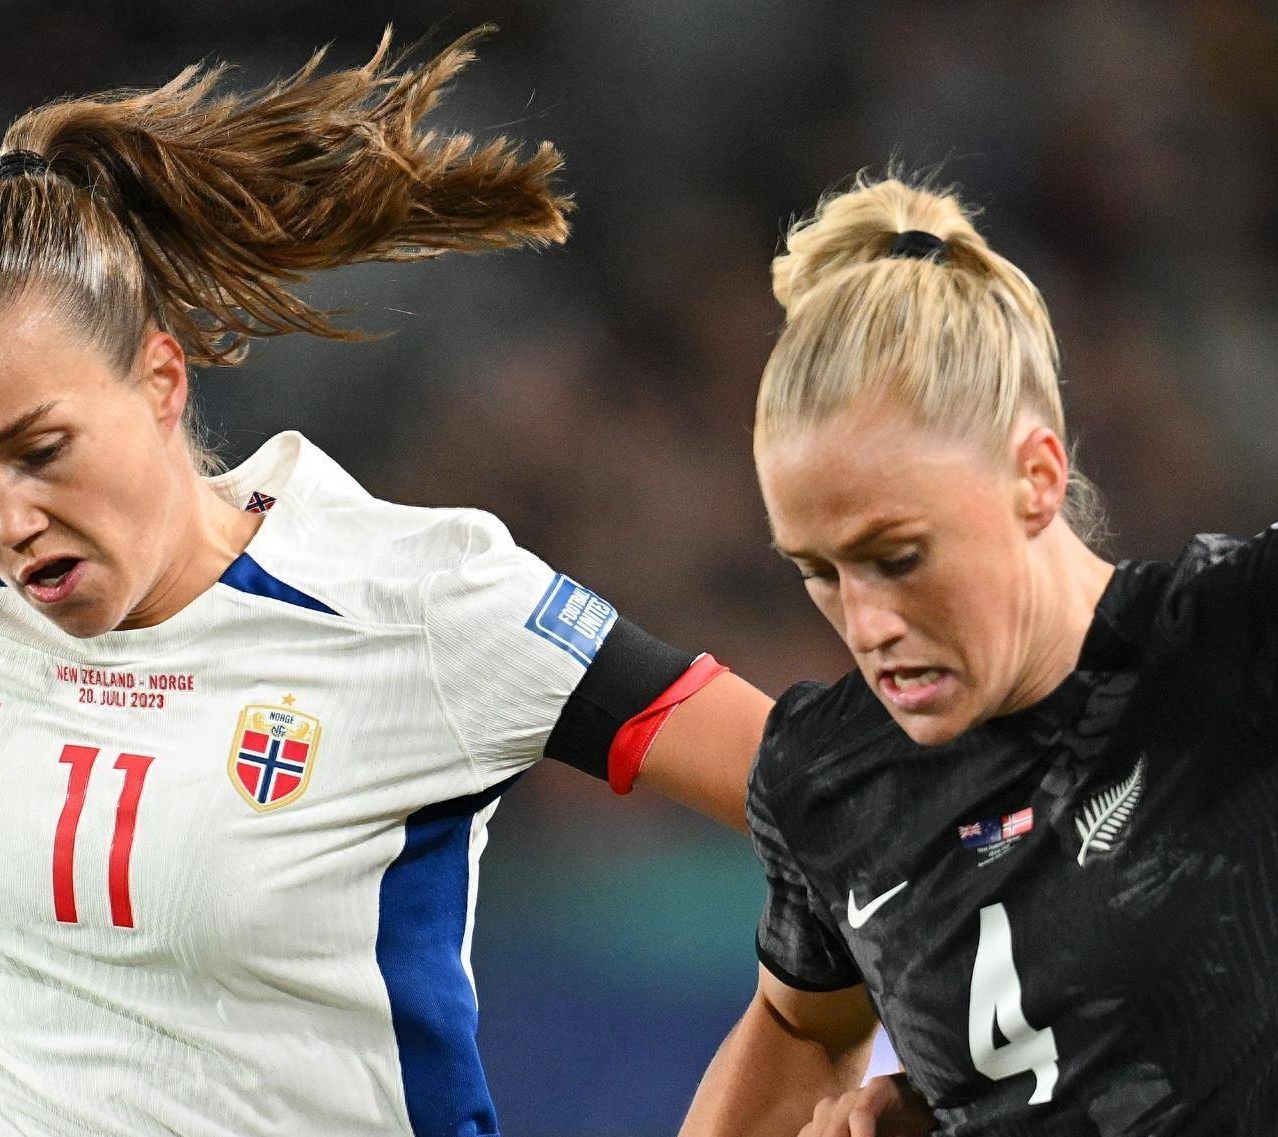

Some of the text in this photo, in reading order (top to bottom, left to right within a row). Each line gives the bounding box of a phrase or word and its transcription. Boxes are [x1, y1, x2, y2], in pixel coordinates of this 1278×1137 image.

[57, 665, 78, 684] NEW
[82, 669, 135, 689] ZEALAND
[149, 674, 195, 691] NORGE
[79, 688, 164, 709] 20. JULI 2023
[269, 711, 295, 724] NORGE
[52, 744, 156, 929] 11
[969, 902, 1058, 1105] 4
